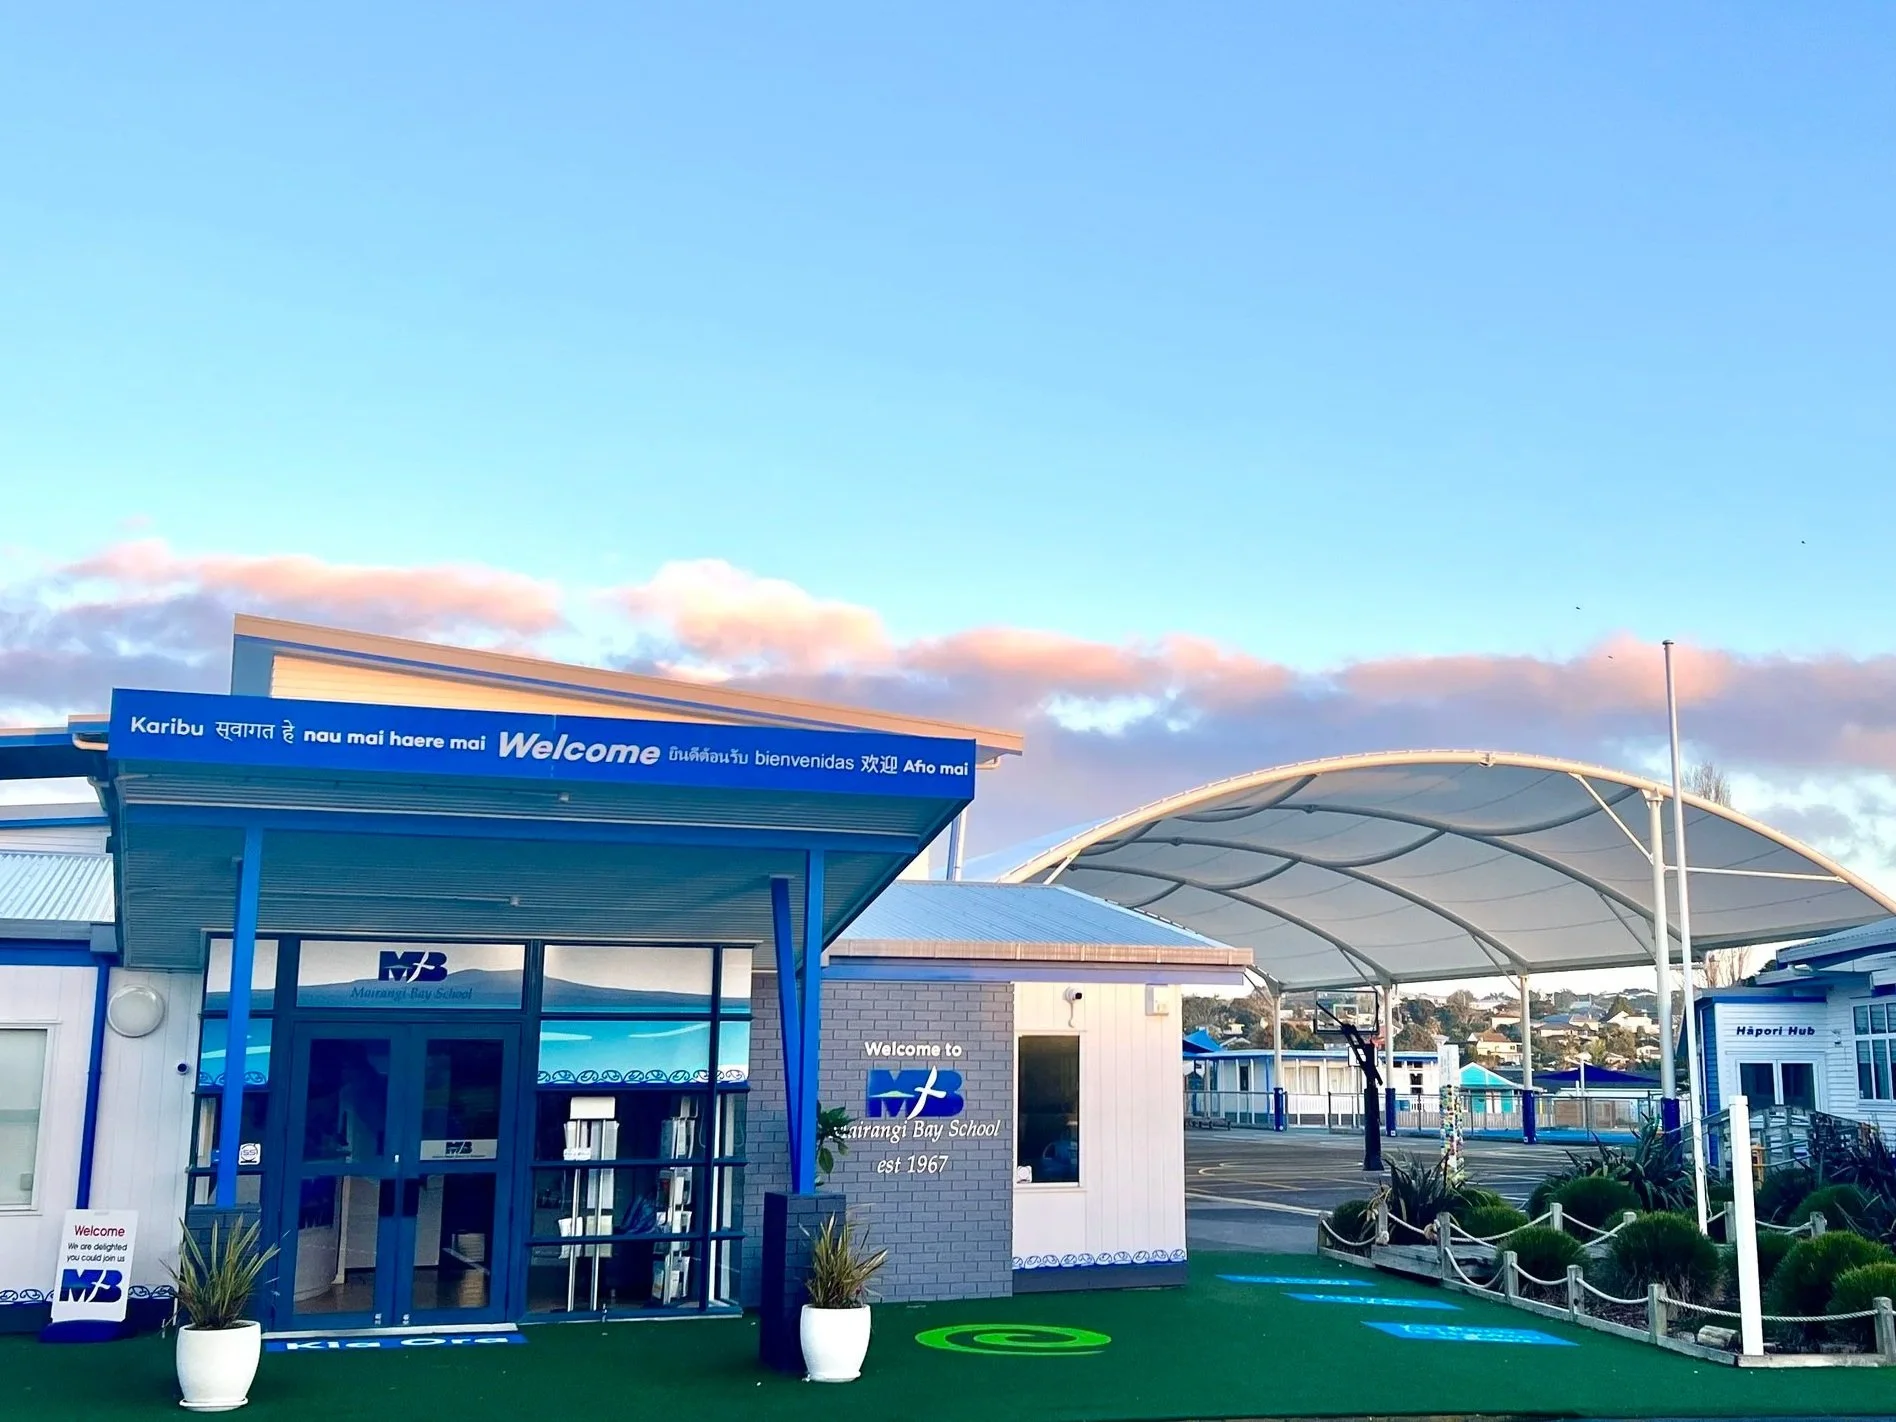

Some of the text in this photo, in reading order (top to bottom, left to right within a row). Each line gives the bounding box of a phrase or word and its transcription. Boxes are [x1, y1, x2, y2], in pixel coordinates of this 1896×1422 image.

[130, 716, 204, 737] Karibu
[303, 729, 486, 751] nau mai haere mai
[499, 731, 661, 765] Welcome
[755, 750, 855, 770] bienvenidas
[861, 754, 898, 775] 欢迎
[903, 759, 969, 776] Afio mai
[378, 950, 448, 983] MB
[350, 986, 473, 1001] Mairangi Bay School
[1736, 1026, 1816, 1038] Hāpori Hub
[864, 1041, 963, 1058] Welcome to
[866, 1067, 964, 1118] MB
[913, 1121, 944, 1143] Bay
[949, 1119, 1001, 1138] School
[877, 1154, 949, 1173] est 1967
[74, 1225, 125, 1237] Welcome
[67, 1242, 79, 1250] We
[93, 1243, 127, 1252] delighted
[66, 1255, 80, 1263] you
[81, 1254, 101, 1262] could
[102, 1255, 116, 1264] join
[59, 1268, 123, 1303] MB
[286, 1337, 509, 1350] Kia Ora
